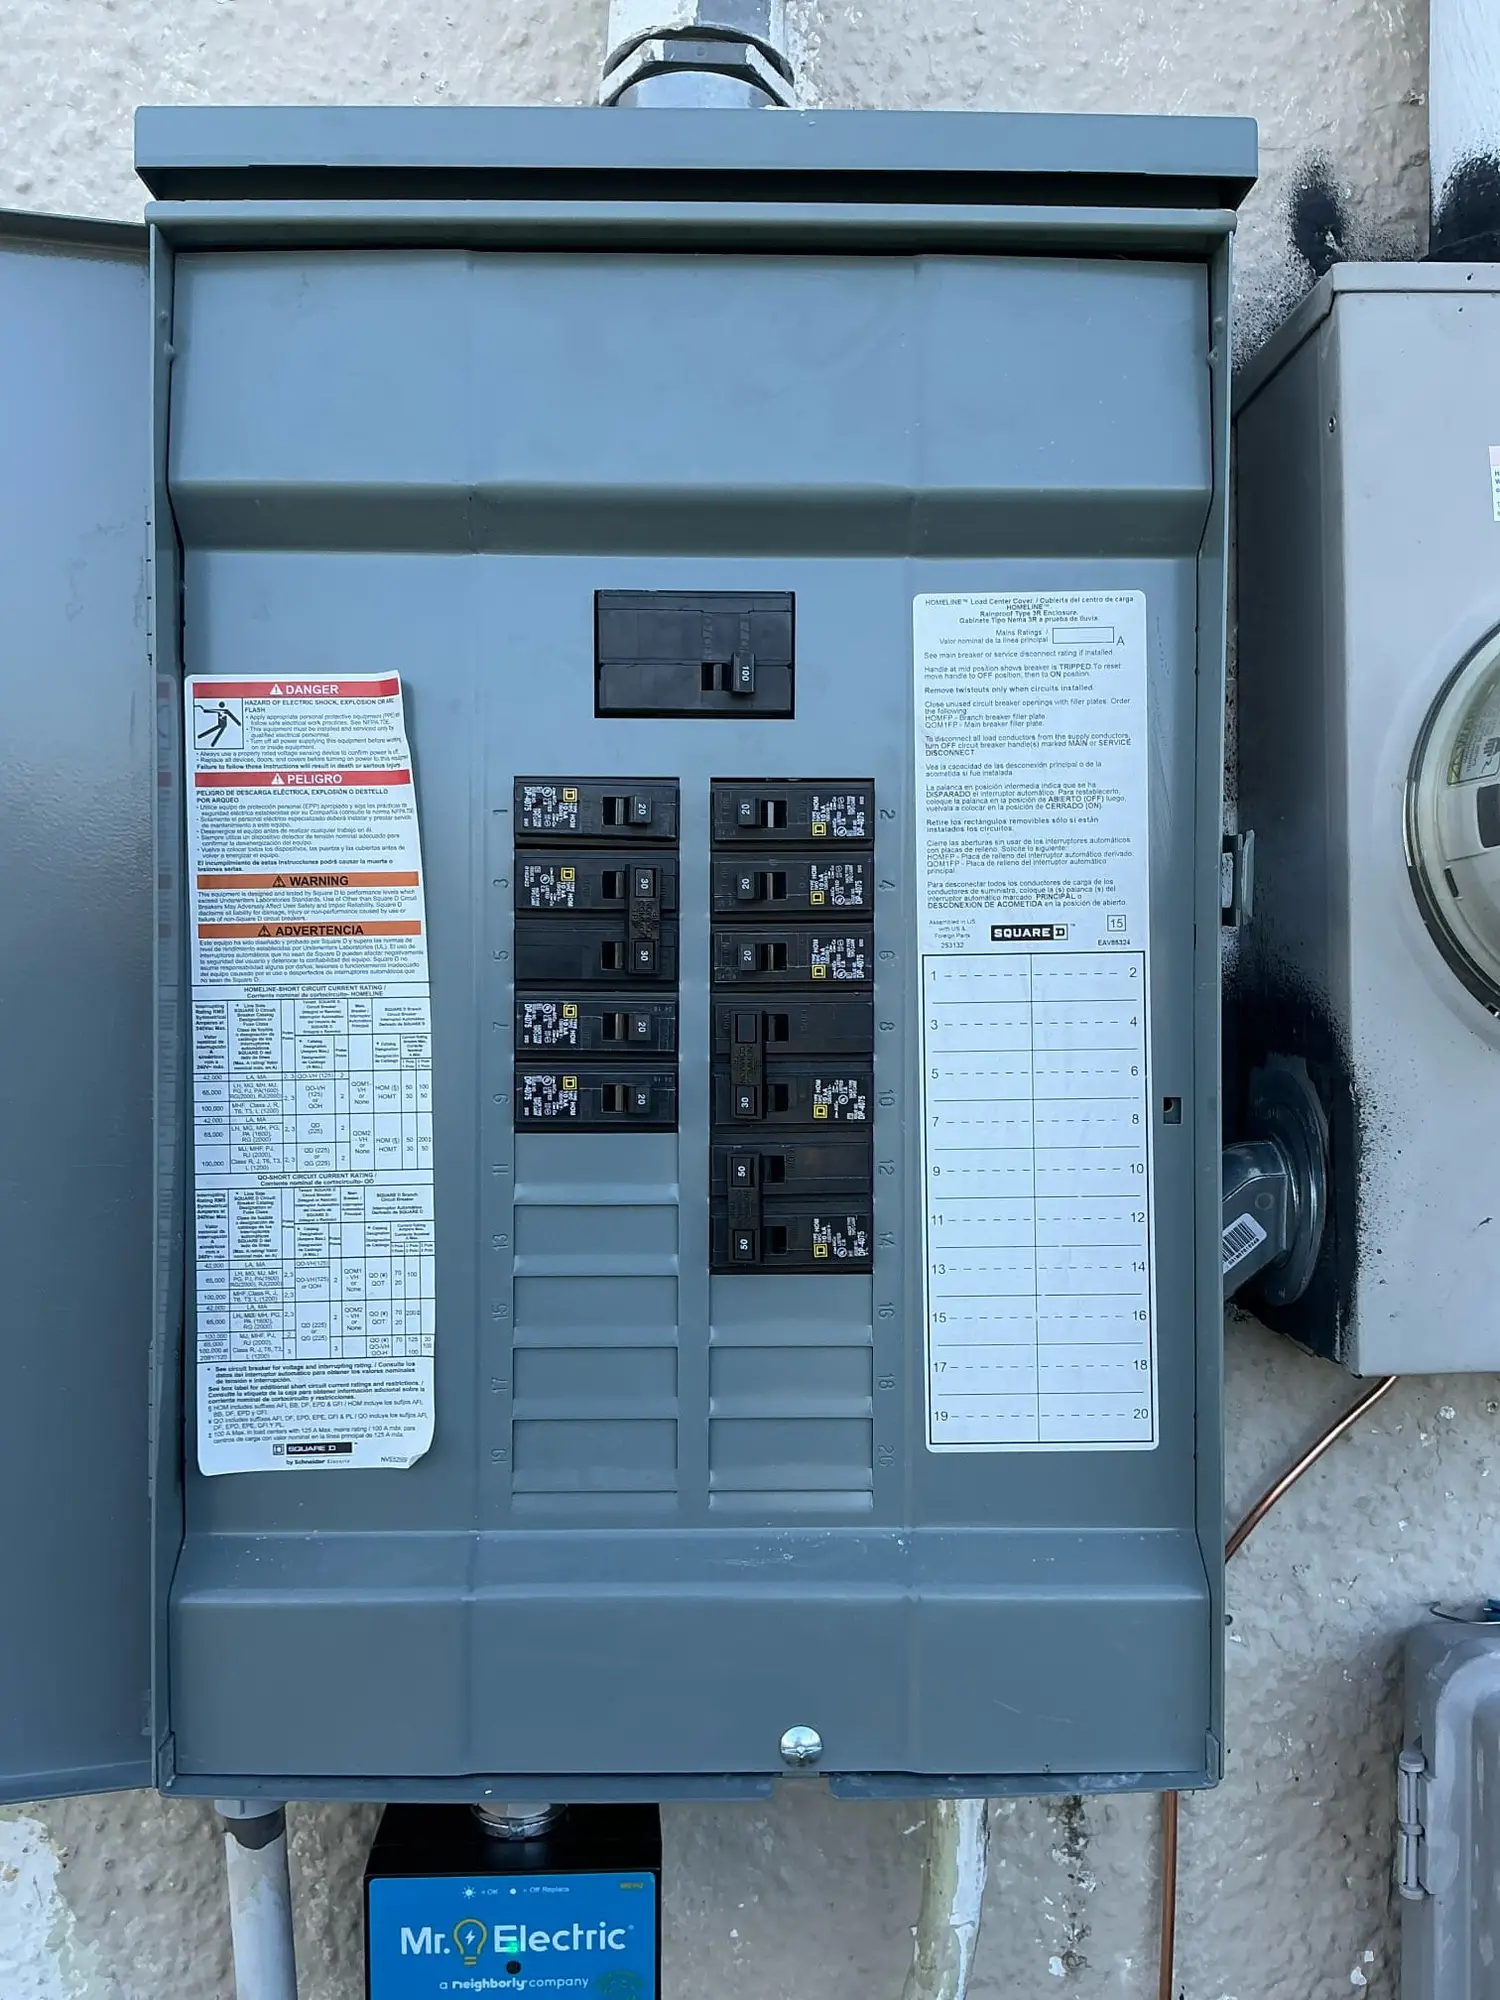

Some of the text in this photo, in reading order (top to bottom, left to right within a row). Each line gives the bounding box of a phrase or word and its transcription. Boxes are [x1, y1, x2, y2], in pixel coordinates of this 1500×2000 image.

[1116, 636, 1124, 645] A
[741, 666, 749, 681] 100
[286, 685, 339, 695] DANGER
[288, 774, 342, 784] PELIGRO
[638, 804, 646, 815] 20
[742, 804, 750, 815] 20
[879, 809, 896, 820] 2
[290, 876, 349, 886] WARNING
[493, 879, 508, 888] 3
[641, 879, 648, 889] 30
[742, 878, 750, 889] 20
[1110, 918, 1122, 928] 15
[276, 925, 364, 936] ADVERTENCIA
[994, 927, 1050, 937] SQUARE
[493, 951, 508, 962] 5
[641, 951, 648, 961] 30
[744, 951, 751, 961] 20
[931, 971, 937, 981] 1
[1129, 967, 1137, 978] 2
[493, 1022, 511, 1031] 7
[879, 1022, 895, 1031] 8
[931, 1020, 938, 1030] 3
[1130, 1016, 1137, 1027] 4
[638, 1022, 646, 1032] 20
[931, 1069, 939, 1079] 5
[1131, 1066, 1138, 1076] 6
[493, 1094, 509, 1104] 9
[638, 1094, 646, 1105] 20
[741, 1097, 749, 1108] 30
[878, 1090, 895, 1107] 10
[932, 1117, 939, 1127] 7
[1132, 1114, 1139, 1124] 8
[738, 1166, 746, 1177] 50
[878, 1160, 895, 1176] 12
[933, 1166, 940, 1176] 9
[1130, 1164, 1144, 1174] 10
[931, 1215, 944, 1225] 11
[1131, 1212, 1145, 1223] 12
[741, 1239, 748, 1250] 50
[877, 1232, 896, 1247] 14
[932, 1265, 946, 1275] 13
[1132, 1262, 1145, 1272] 14
[932, 1313, 947, 1323] 15
[1133, 1311, 1147, 1321] 16
[933, 1363, 947, 1373] 17
[1134, 1360, 1148, 1370] 18
[934, 1412, 948, 1422] 19
[1133, 1409, 1149, 1419] 20
[400, 1921, 626, 1954] Mr. Electric
[439, 1977, 588, 1991] a neighborly company
